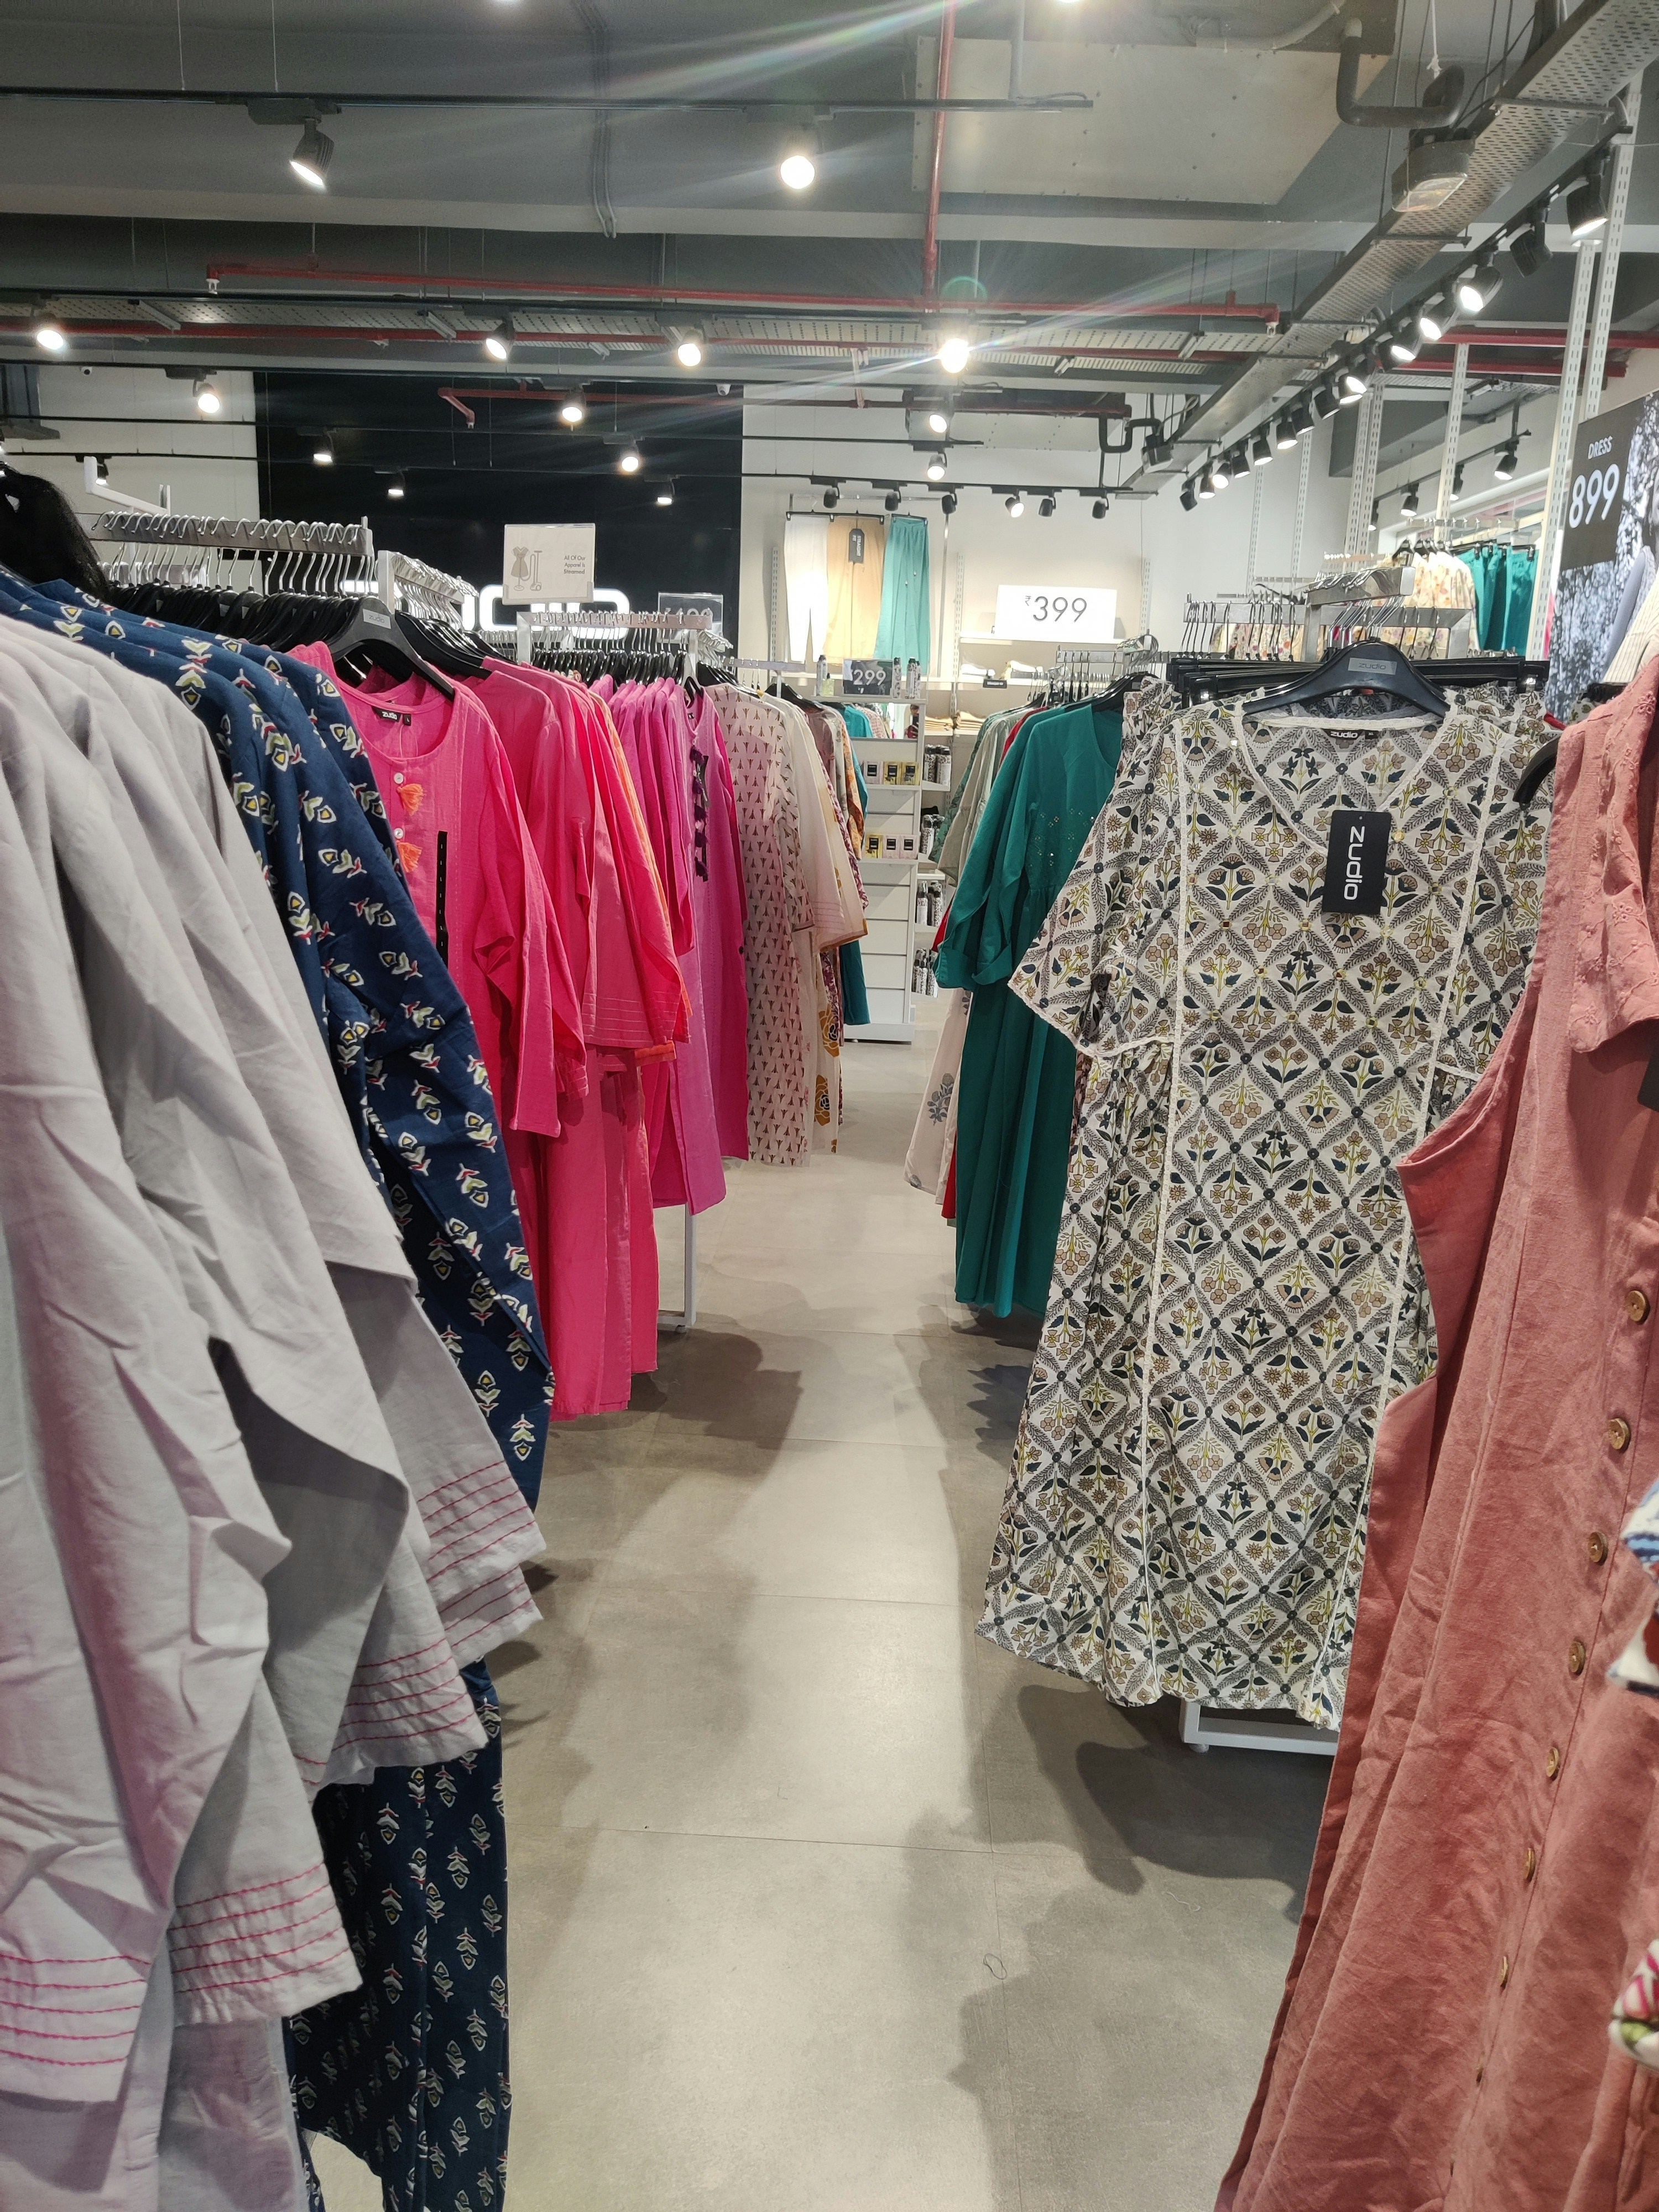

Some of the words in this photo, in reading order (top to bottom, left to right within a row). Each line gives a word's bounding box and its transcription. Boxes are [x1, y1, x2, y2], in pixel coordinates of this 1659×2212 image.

[1588, 436, 1613, 460] DRESS
[1569, 463, 1620, 529] 899
[1344, 826, 1365, 900] zudio
